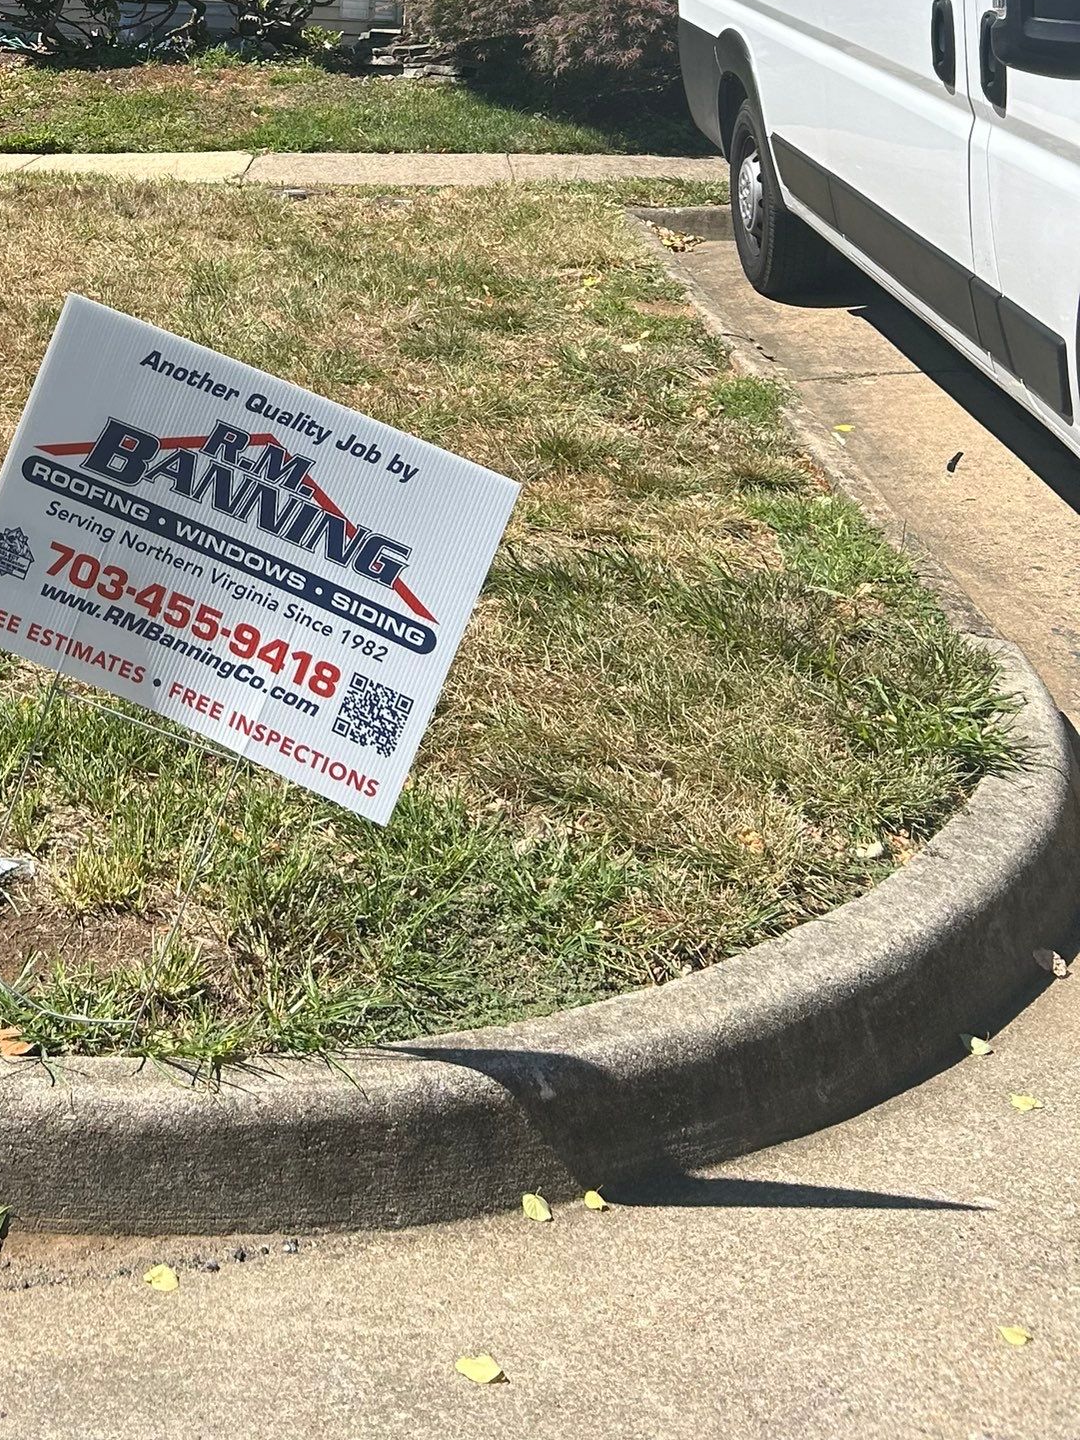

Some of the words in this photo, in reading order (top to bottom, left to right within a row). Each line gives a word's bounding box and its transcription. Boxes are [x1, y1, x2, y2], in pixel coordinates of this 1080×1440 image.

[139, 350, 240, 401] Another
[245, 393, 333, 446] Quality
[336, 434, 383, 461] Job
[386, 453, 420, 483] by
[199, 418, 317, 500] R.M.
[31, 461, 152, 523] ROOFING
[175, 519, 307, 591] WINDOWS
[330, 592, 427, 647] SIDING
[45, 500, 116, 543] Serving
[118, 530, 204, 578] Northern
[210, 567, 280, 612] Virginia
[282, 603, 334, 637] Since
[341, 629, 390, 663] 1982
[79, 416, 413, 590] BANNING
[39, 582, 321, 718] www.RMBanningCo.com
[46, 540, 342, 699] 703-455-9418
[26, 622, 147, 684] ESTIMATES
[168, 681, 225, 721] FREE
[228, 711, 381, 799] INSPECTIONS
